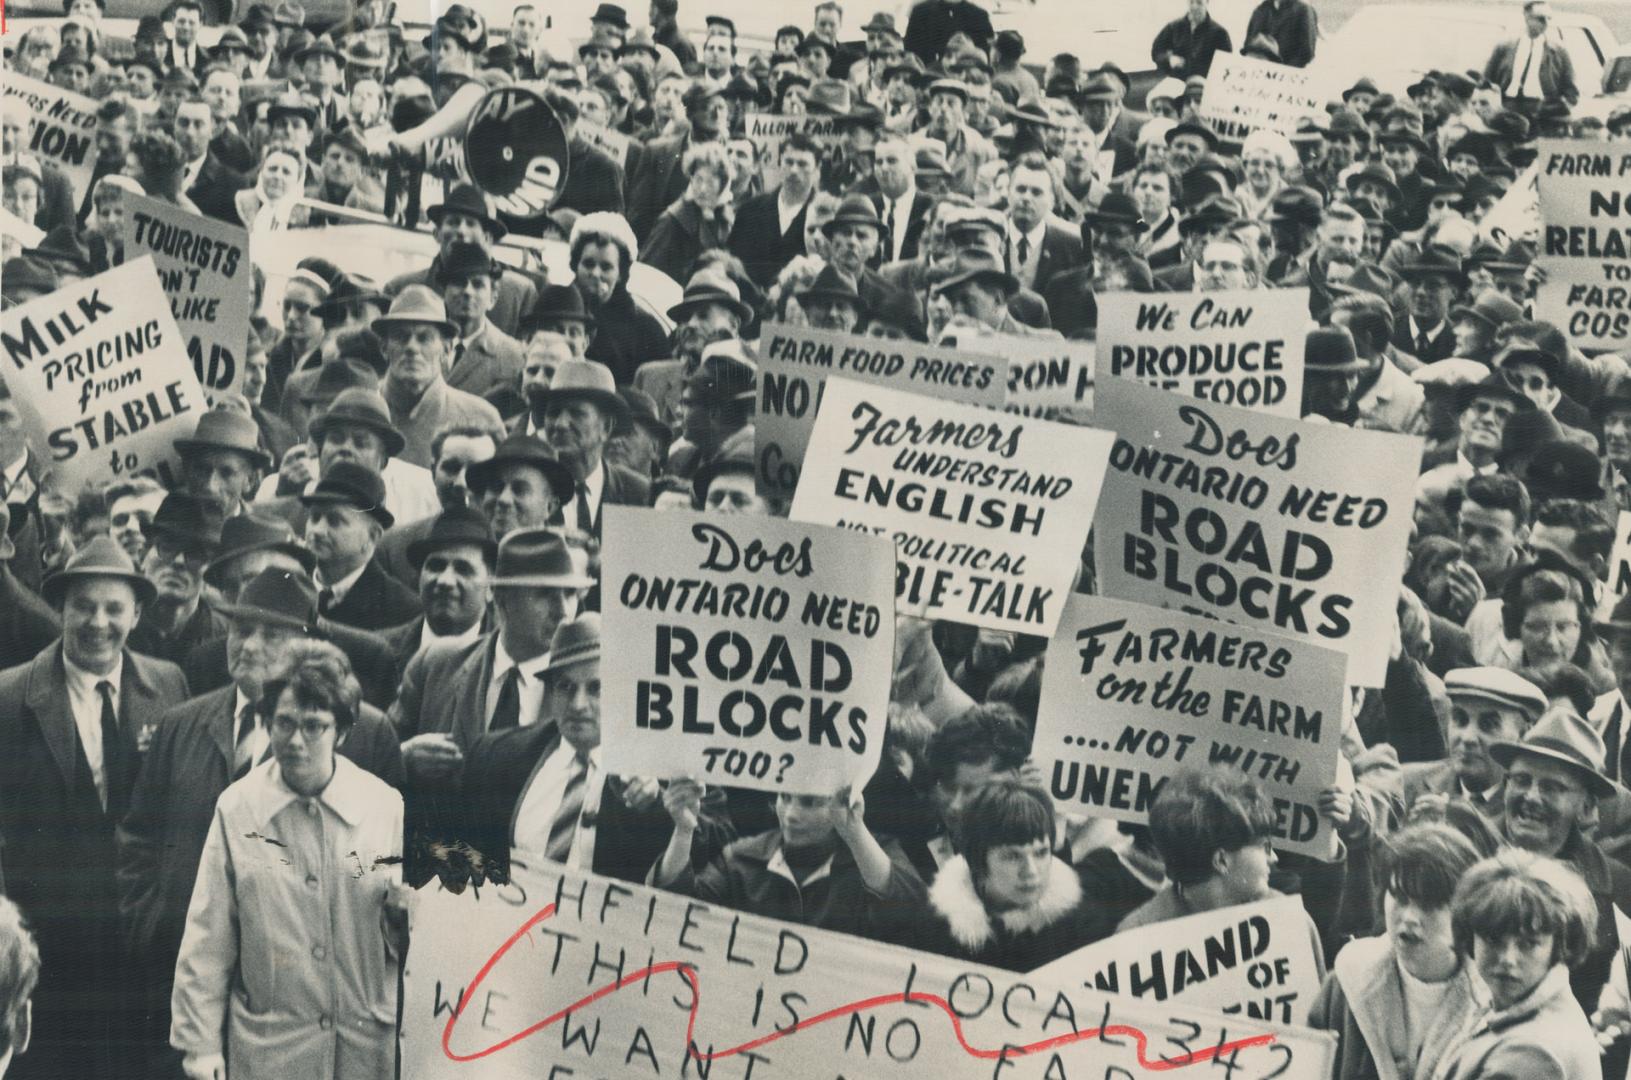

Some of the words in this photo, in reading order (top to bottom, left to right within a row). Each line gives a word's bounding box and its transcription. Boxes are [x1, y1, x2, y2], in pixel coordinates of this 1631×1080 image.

[1546, 153, 1612, 177] FARM
[1590, 190, 1631, 217] N
[133, 212, 240, 279] TOURISTS
[1602, 264, 1631, 281] TO
[1, 288, 113, 370] MILK
[170, 297, 220, 322] LIKE
[42, 320, 162, 391] PRICING
[769, 336, 833, 369] FARM
[839, 347, 905, 376] FOOD
[910, 357, 995, 391] PRICES
[1111, 340, 1284, 377] PRODUCE
[47, 380, 191, 462] STABLE
[78, 367, 142, 415] from
[762, 372, 810, 419] NO
[1193, 375, 1287, 406] FOOD
[844, 401, 1023, 459] Farmers
[1179, 406, 1300, 471] Does
[109, 449, 138, 475] to
[893, 448, 1073, 500] UNDERSTAND
[1109, 439, 1269, 511] ONTARIO
[1279, 484, 1388, 529] NEED
[834, 468, 1046, 537] ENGLISH
[692, 522, 814, 578] Does
[1141, 490, 1333, 582] ROAD
[620, 573, 791, 623] ONTARIO
[800, 591, 881, 639] NEED
[1124, 532, 1353, 639] BLOCKS
[655, 624, 853, 694] ROAD
[1075, 619, 1292, 679] FARMERS
[636, 680, 868, 755] BLOCKS
[1096, 673, 1148, 705] on
[1151, 666, 1211, 718] the
[1222, 689, 1323, 744] FARM
[702, 747, 795, 784] TOO?
[1207, 740, 1301, 786] WITH
[438, 859, 808, 976] SHFIELD
[904, 962, 1127, 1047] LOCAL
[1159, 1017, 1293, 1080] 342
[1129, 915, 1271, 1001] HAND
[1247, 957, 1291, 990] OF
[541, 926, 700, 1010] THIS
[752, 983, 808, 1034] IS
[845, 1011, 921, 1063] NO
[433, 980, 508, 1032] WE
[562, 1010, 772, 1080] WANT
